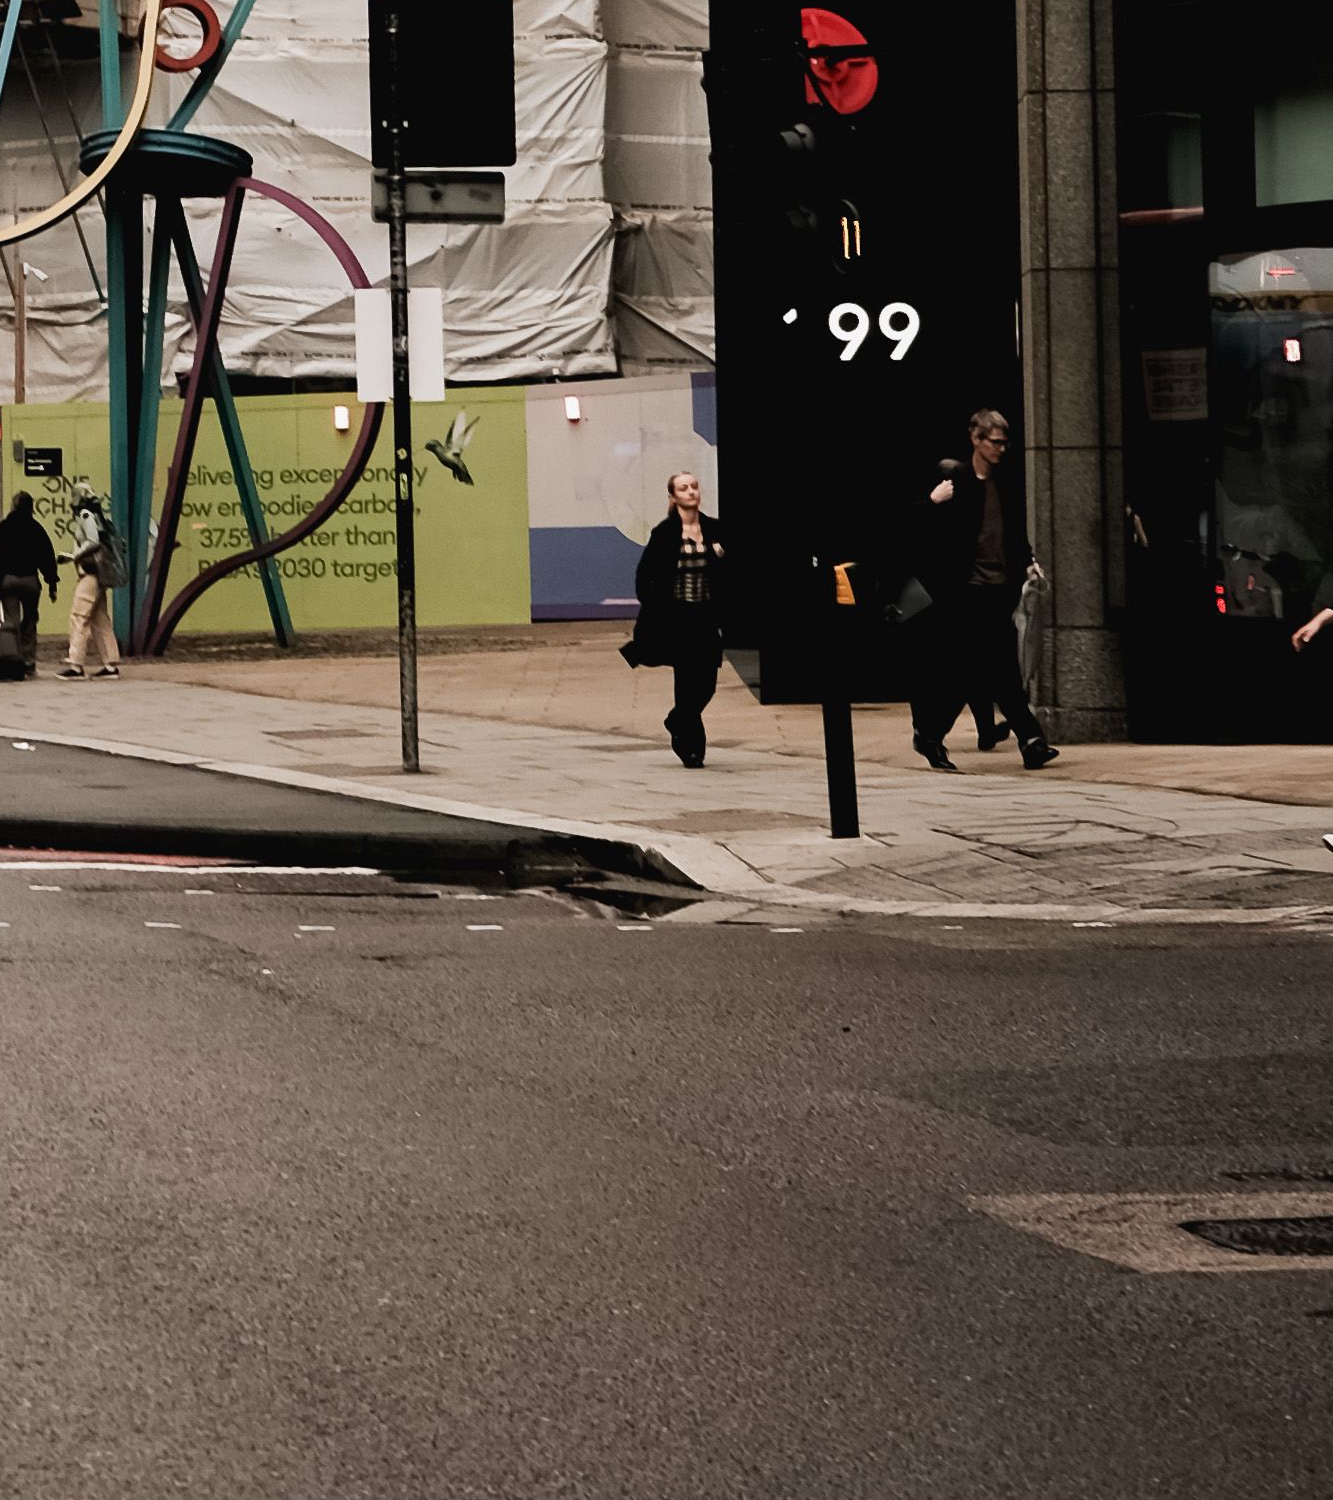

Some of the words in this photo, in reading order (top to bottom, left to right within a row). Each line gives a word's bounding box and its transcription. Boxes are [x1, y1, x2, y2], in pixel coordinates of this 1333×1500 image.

[783, 302, 920, 361] 99
[180, 502, 212, 517] ow
[345, 525, 396, 545] than
